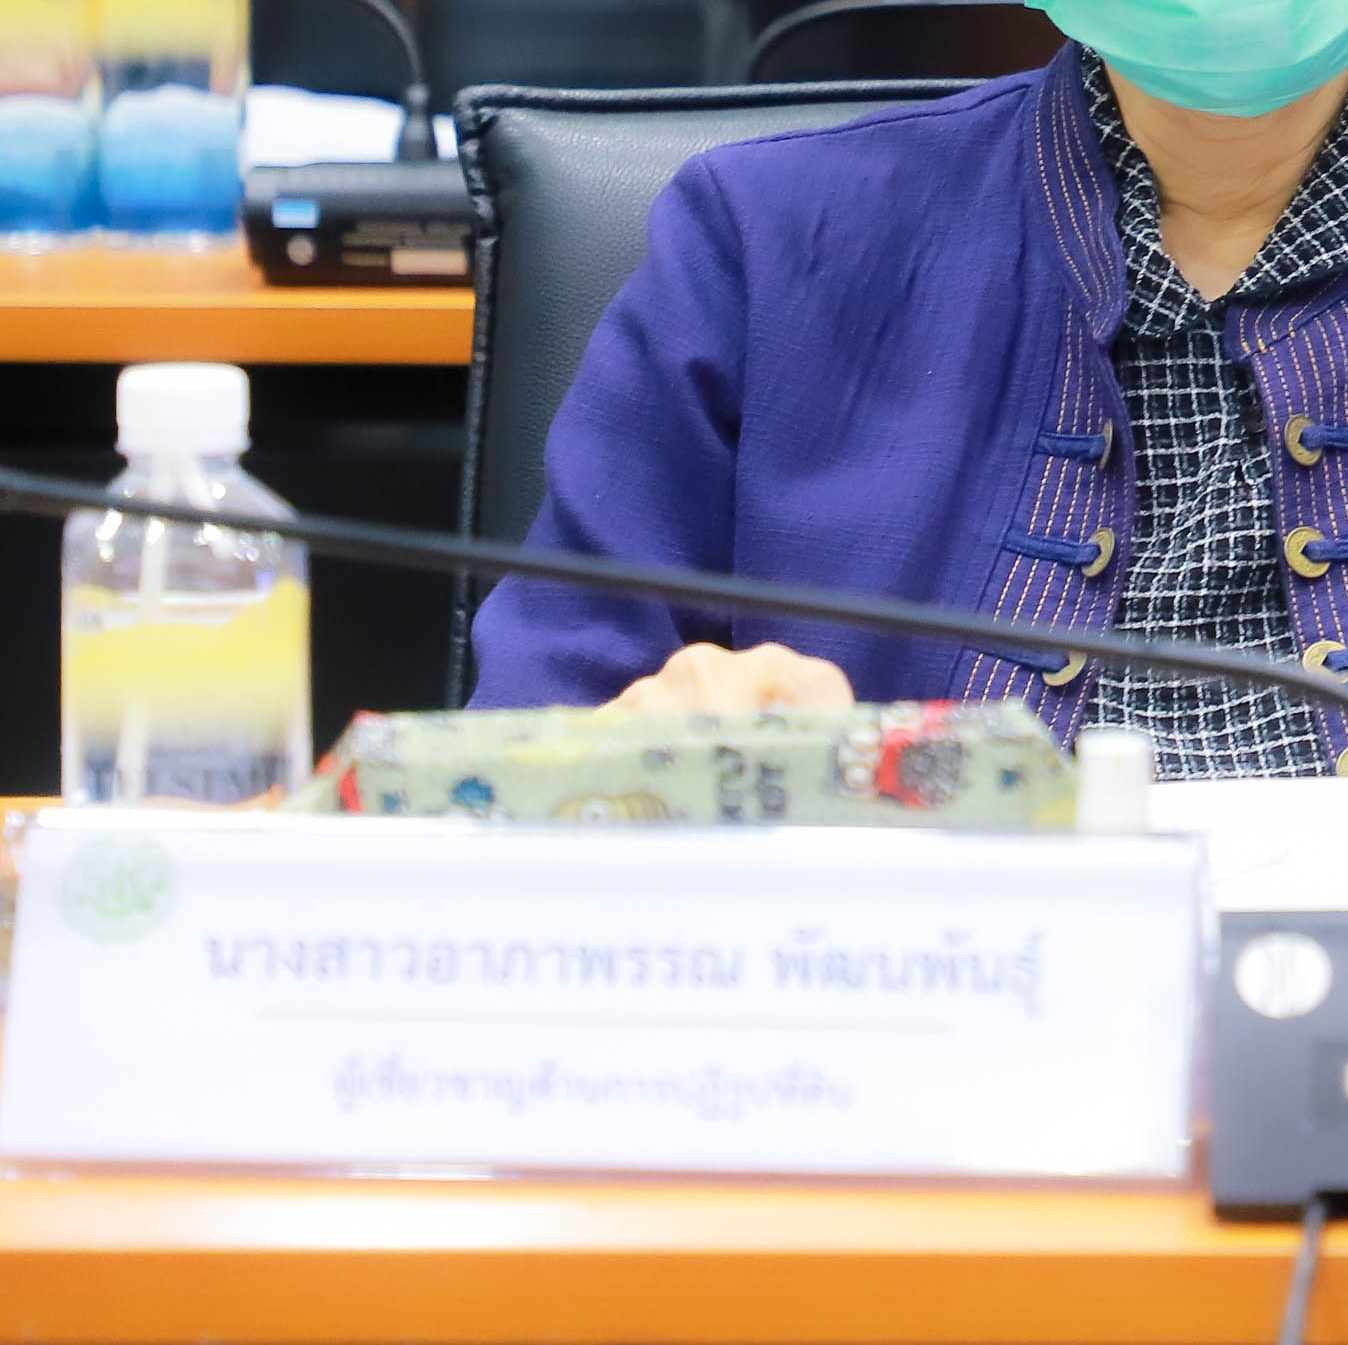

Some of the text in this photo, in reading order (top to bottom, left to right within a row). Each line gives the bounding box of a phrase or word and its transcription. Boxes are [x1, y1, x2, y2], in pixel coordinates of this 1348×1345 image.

[204, 933, 746, 991] นางสาวอาภาพรรณ
